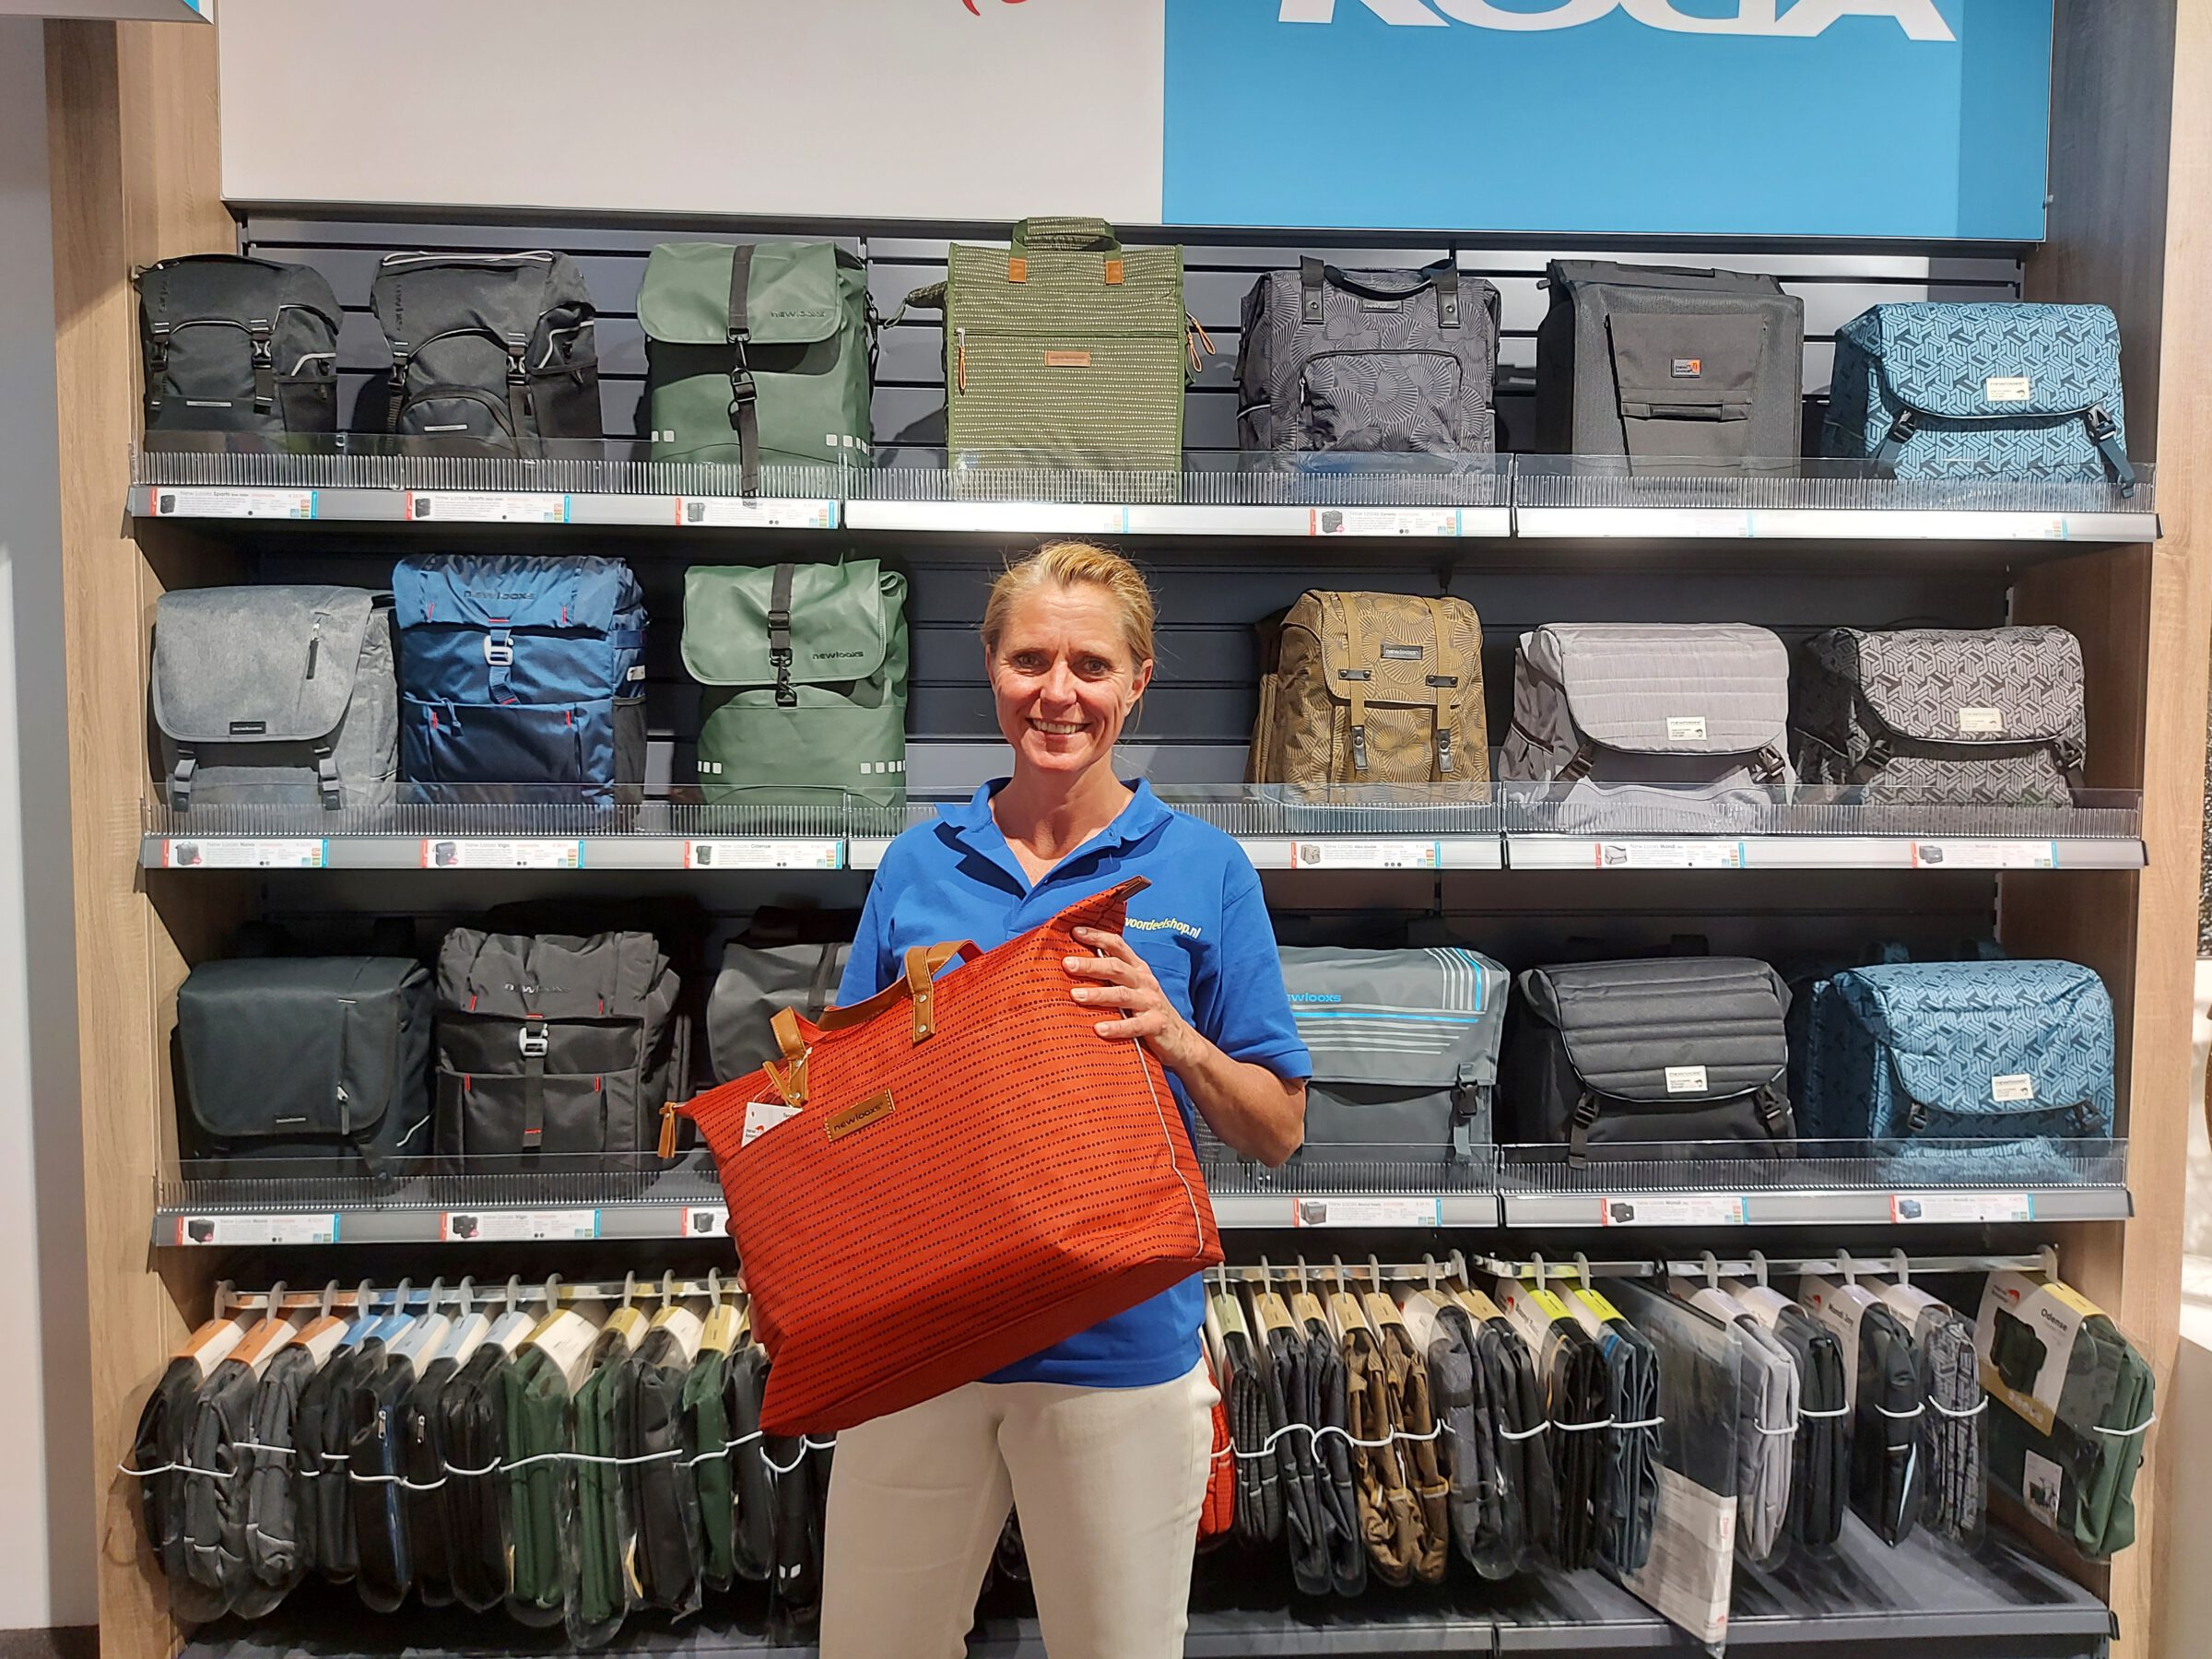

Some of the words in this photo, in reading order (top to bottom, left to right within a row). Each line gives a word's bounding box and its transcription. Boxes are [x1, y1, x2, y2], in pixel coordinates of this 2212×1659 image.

[812, 651, 864, 660] newlooxs
[1124, 916, 1202, 940] voordeelshop.nl
[2041, 1307, 2069, 1333] Odense
